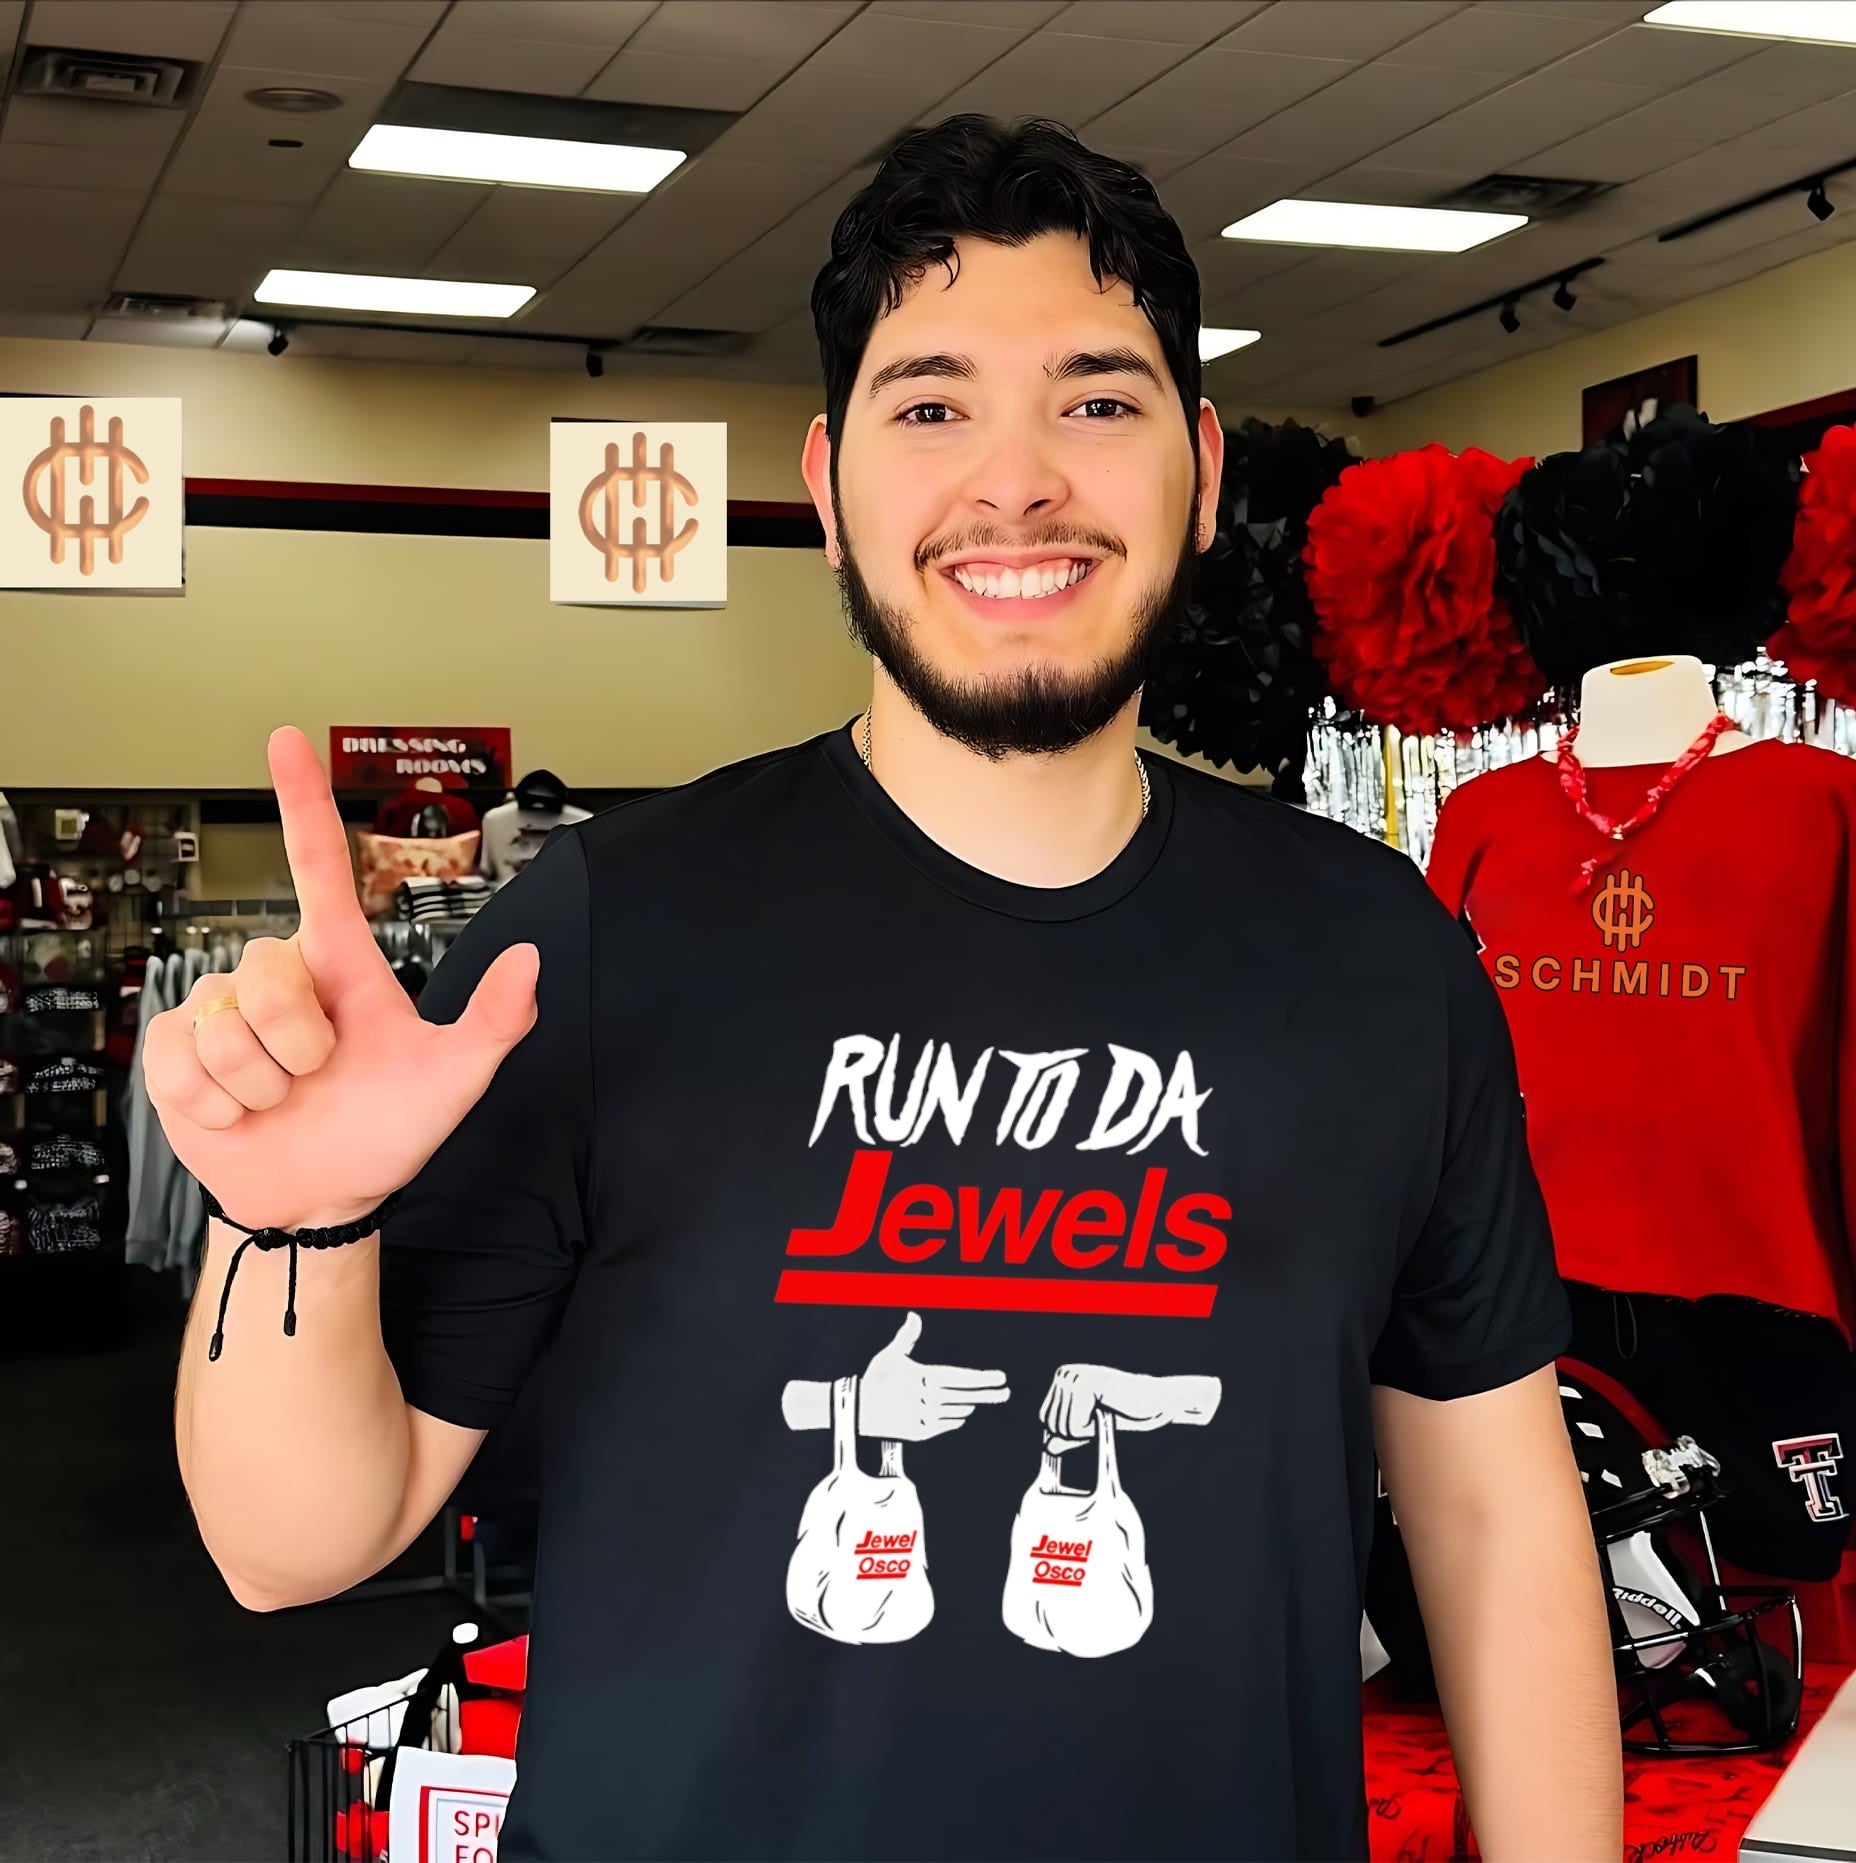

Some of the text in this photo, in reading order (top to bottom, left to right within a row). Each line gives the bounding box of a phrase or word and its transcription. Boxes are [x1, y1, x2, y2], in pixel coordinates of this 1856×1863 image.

[342, 737, 467, 754] DRESSING
[396, 758, 487, 775] ROOMS
[1494, 953, 1746, 1000] SCHMIDT
[808, 1033, 1213, 1156] RUN TO DA
[785, 1150, 1233, 1272] Jewels
[856, 1530, 917, 1548] Jewel
[1032, 1535, 1093, 1556] Jewel
[859, 1557, 911, 1573] Osco
[1034, 1561, 1086, 1580] Osco
